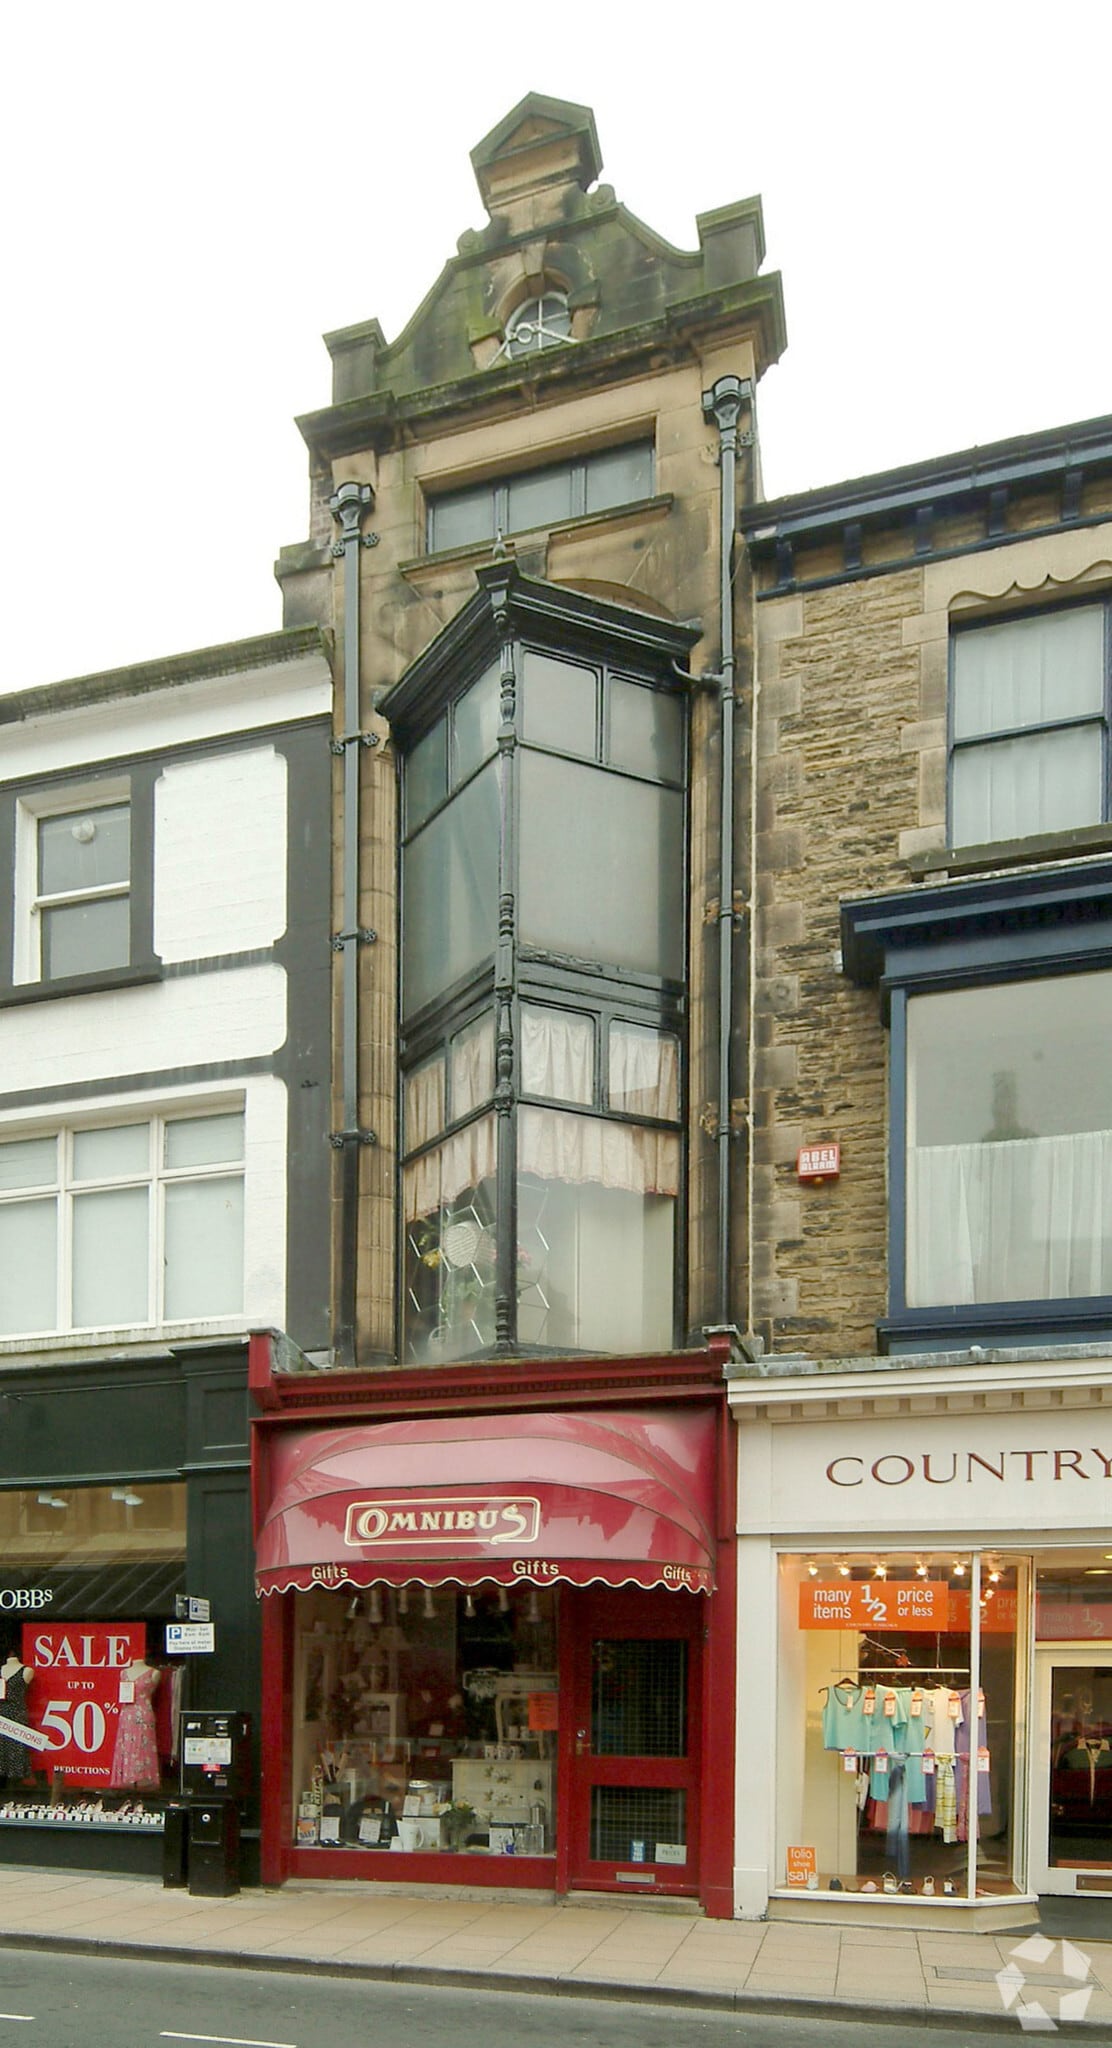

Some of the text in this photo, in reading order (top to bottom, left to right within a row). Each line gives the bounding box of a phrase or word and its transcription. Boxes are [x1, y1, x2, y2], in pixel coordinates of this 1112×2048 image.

[801, 1149, 835, 1162] ABEL
[825, 1448, 1112, 1487] COUNTRY
[356, 1504, 528, 1545] OMNIBUS
[311, 1565, 349, 1580] Gifts
[511, 1560, 559, 1575] Gifts
[663, 1564, 692, 1582] Gifts
[814, 1589, 851, 1605] many
[897, 1587, 934, 1605] price
[813, 1603, 852, 1619] items
[897, 1607, 909, 1617] or
[911, 1605, 934, 1617] less
[171, 1627, 181, 1639] P
[34, 1634, 132, 1668] SALE
[67, 1681, 95, 1690] UP TO
[41, 1701, 119, 1753] 50%
